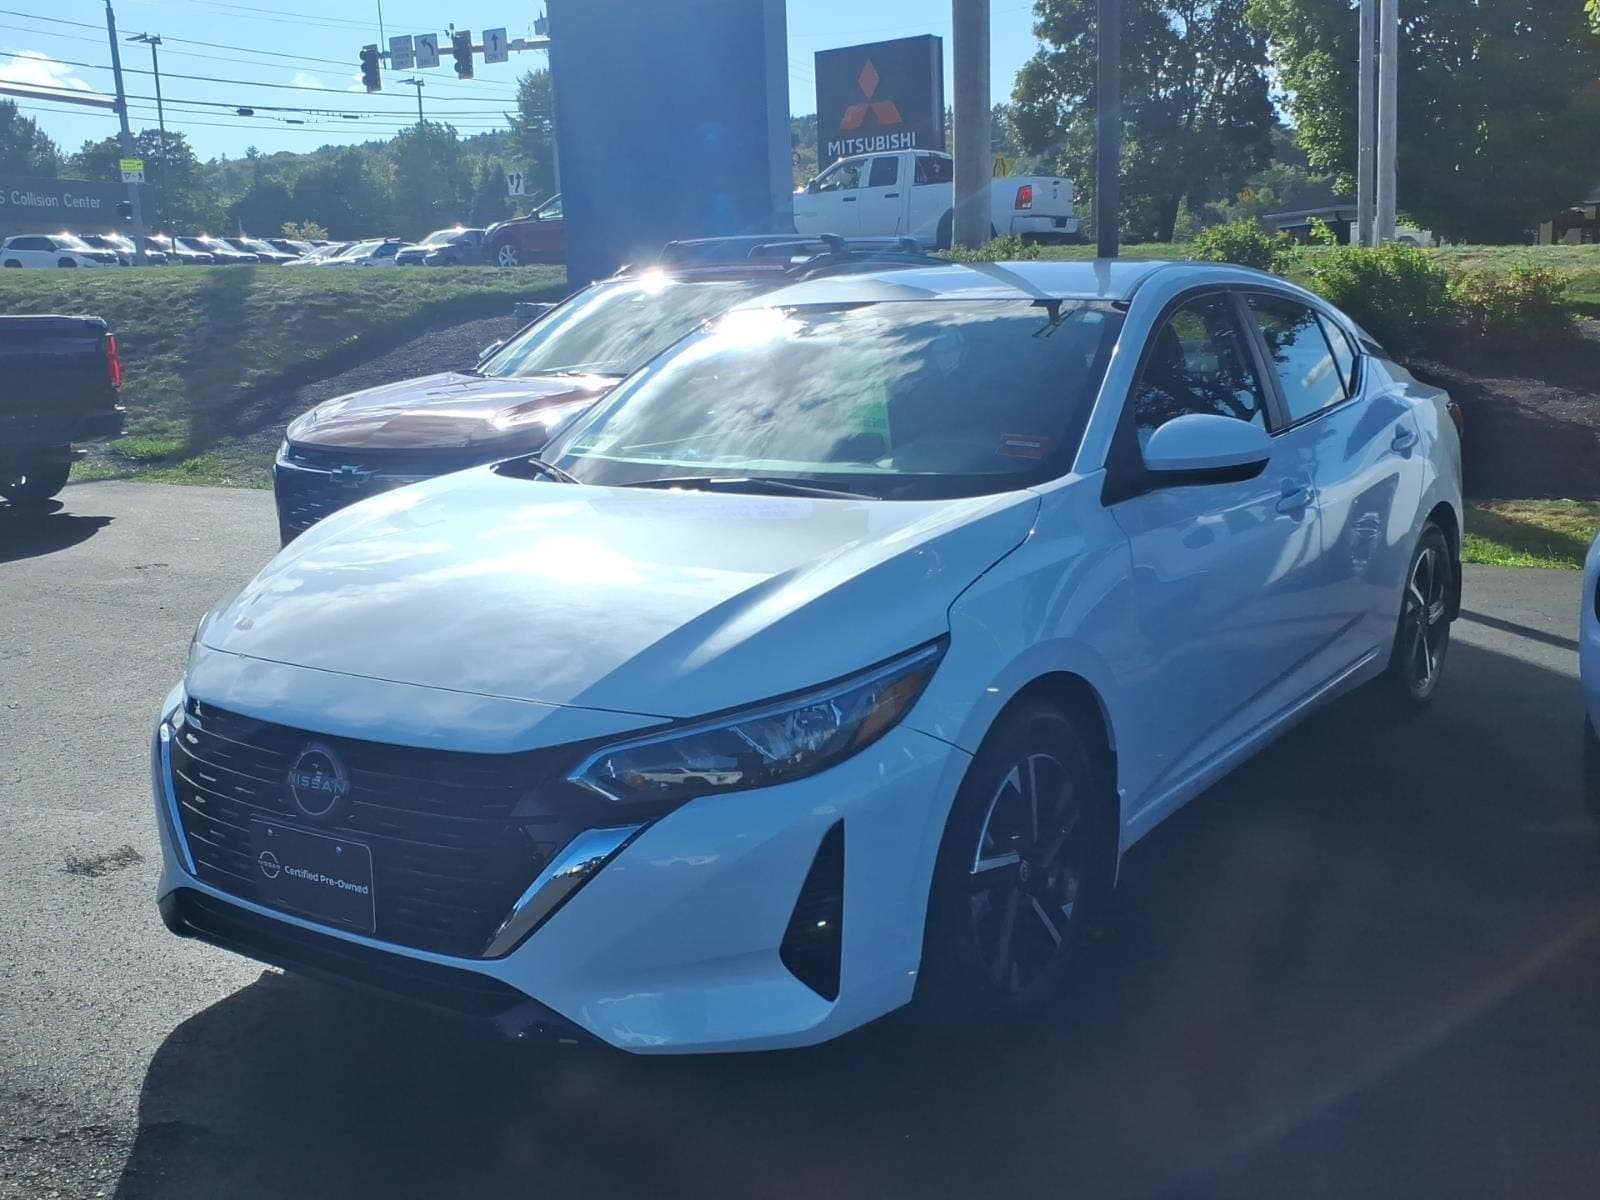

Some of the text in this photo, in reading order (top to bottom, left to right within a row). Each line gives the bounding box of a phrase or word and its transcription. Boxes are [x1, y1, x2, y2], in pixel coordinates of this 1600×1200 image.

[827, 131, 916, 156] MITSUBISHI
[11, 190, 60, 207] Collision
[63, 193, 101, 209] Center
[288, 770, 347, 795] NISSAN
[284, 865, 369, 894] Certified Pre-Owned
